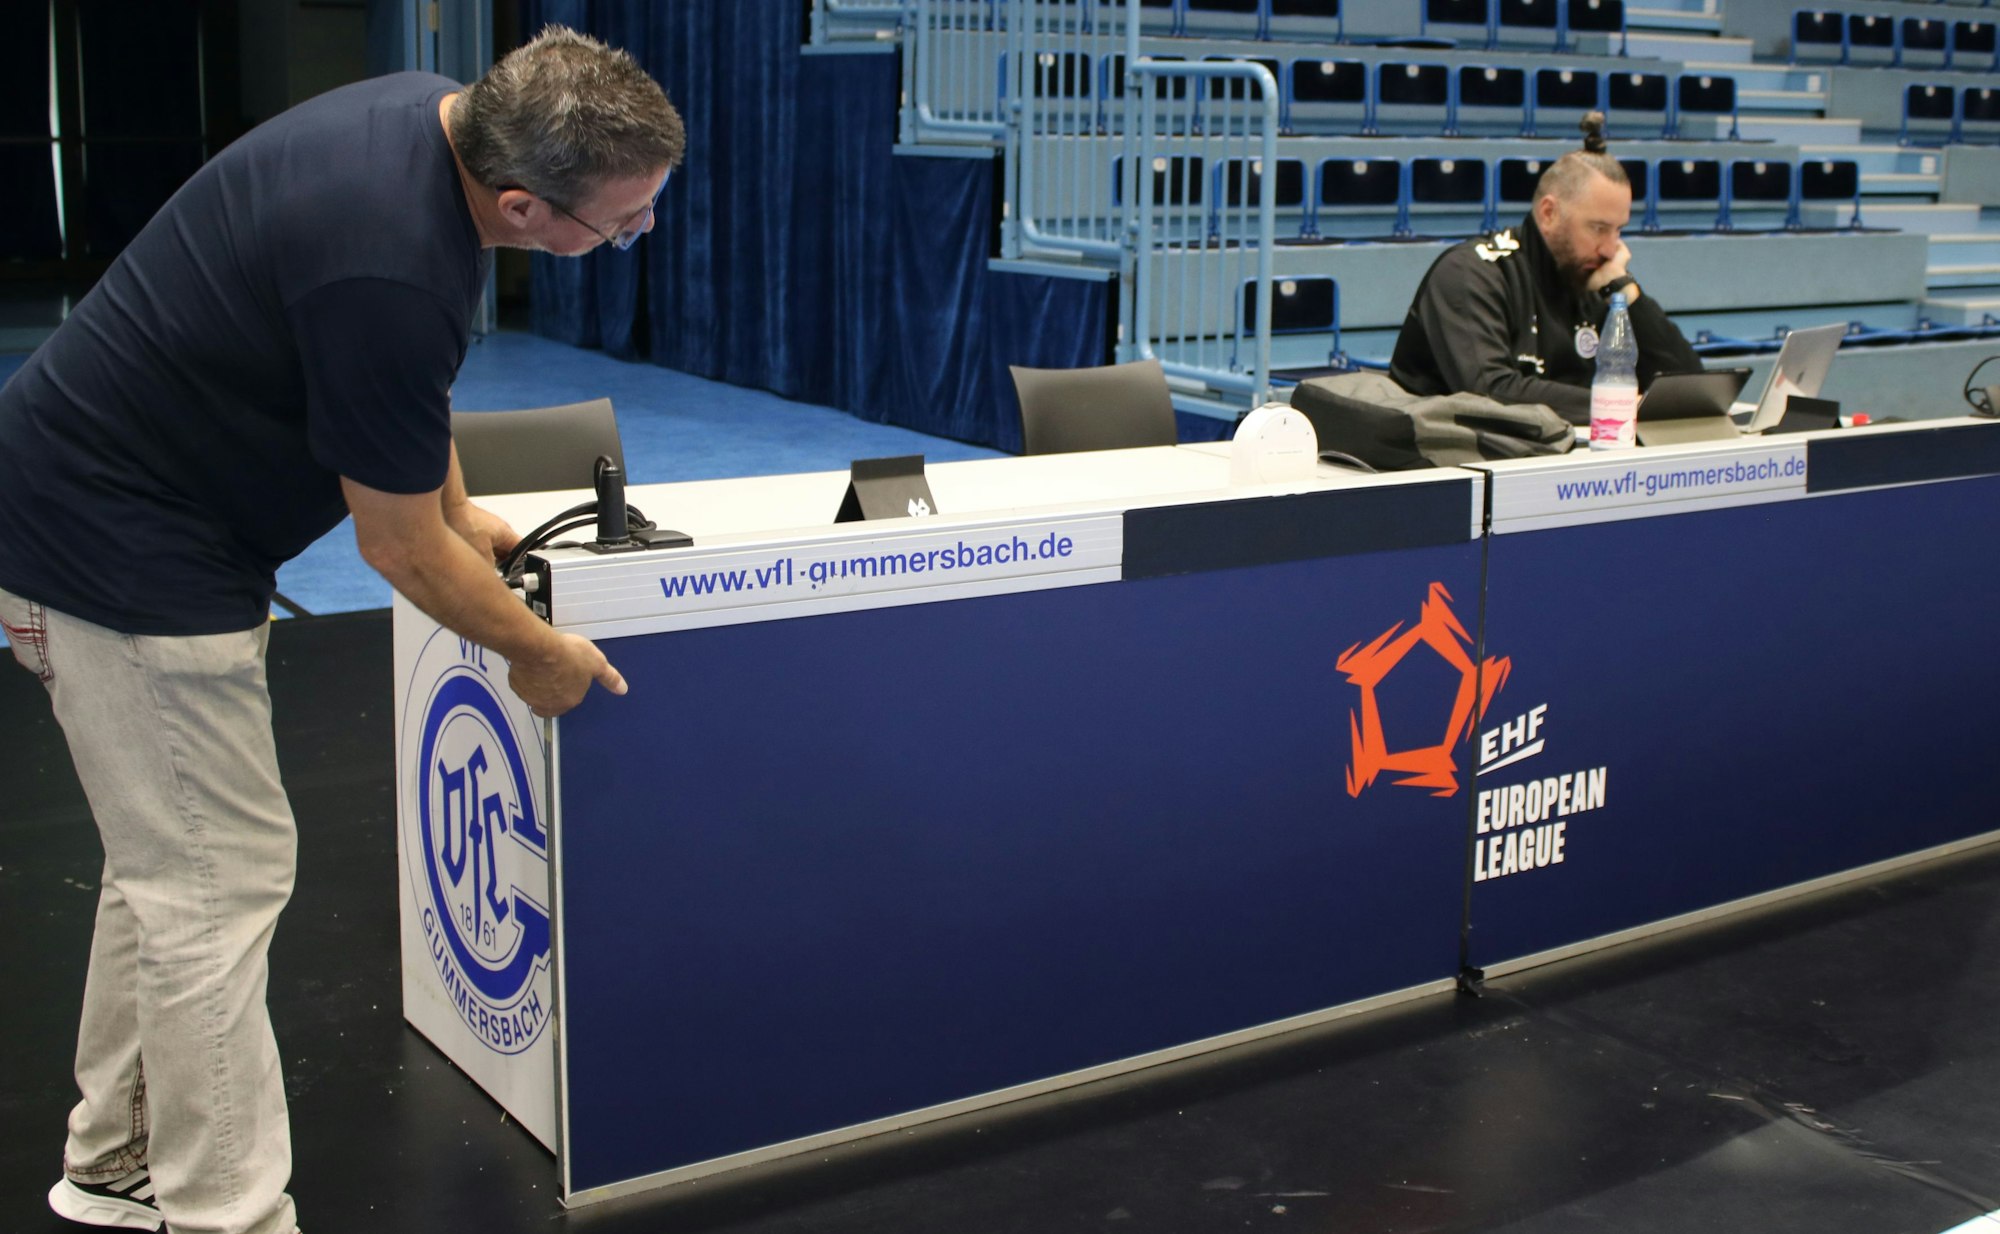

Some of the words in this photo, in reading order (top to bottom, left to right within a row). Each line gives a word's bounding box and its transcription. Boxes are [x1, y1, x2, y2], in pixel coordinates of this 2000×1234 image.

[1557, 456, 1806, 501] www.vfl-gummersbach.de
[1480, 703, 1548, 766] EHF
[1477, 766, 1607, 834] EUROPEAN
[1474, 821, 1566, 882] LEAGUE
[423, 907, 543, 1047] GUMMERSBACH
